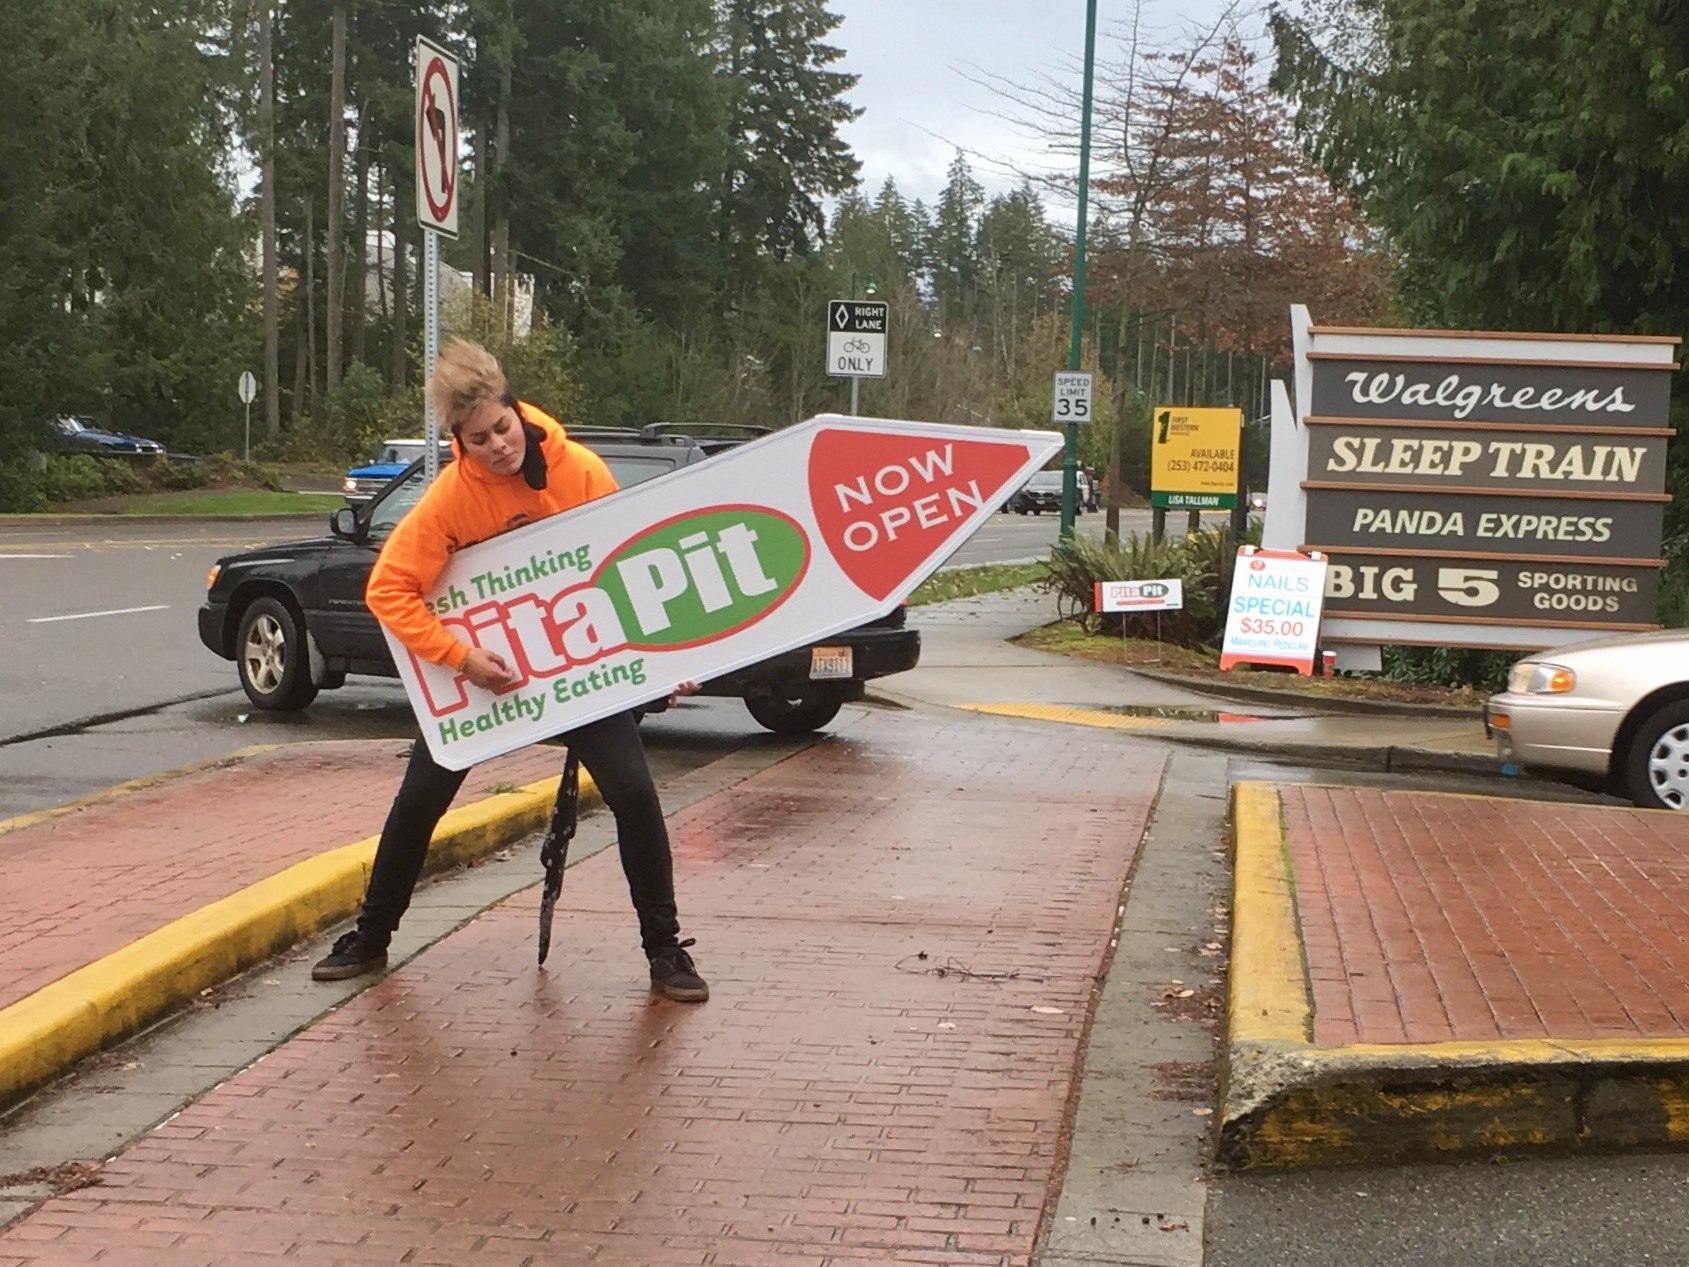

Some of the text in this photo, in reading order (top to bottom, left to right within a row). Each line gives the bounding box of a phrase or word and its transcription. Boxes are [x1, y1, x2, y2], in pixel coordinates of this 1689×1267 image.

[854, 306, 885, 317] RIGHT
[855, 320, 882, 330] LANE
[838, 356, 874, 371] ONLY
[1057, 377, 1090, 387] SPEED
[1060, 388, 1087, 396] LIMIT
[1344, 372, 1636, 419] Walgreens
[1057, 398, 1088, 416] 35
[1190, 448, 1235, 460] AVAILABLE
[1327, 436, 1647, 482] SLEEP TRAIN
[1167, 460, 1234, 473] (253) 472-0404
[834, 443, 953, 513] NOW
[1168, 495, 1184, 504] LISA
[843, 480, 986, 552] OPEN
[1353, 508, 1613, 543] PANDA EXPRESS
[424, 544, 594, 615] esh Thinking
[616, 522, 778, 636] Pit
[1248, 573, 1309, 592] NAILS
[1325, 565, 1500, 607] BIG 5
[1517, 571, 1638, 593] SPORTING
[1110, 585, 1163, 598] Pita Pit
[1233, 595, 1315, 618] SPECIAL
[1533, 593, 1620, 612] GOODS
[1240, 617, 1304, 636] $35.00
[438, 658, 647, 745] Healthy Eating
